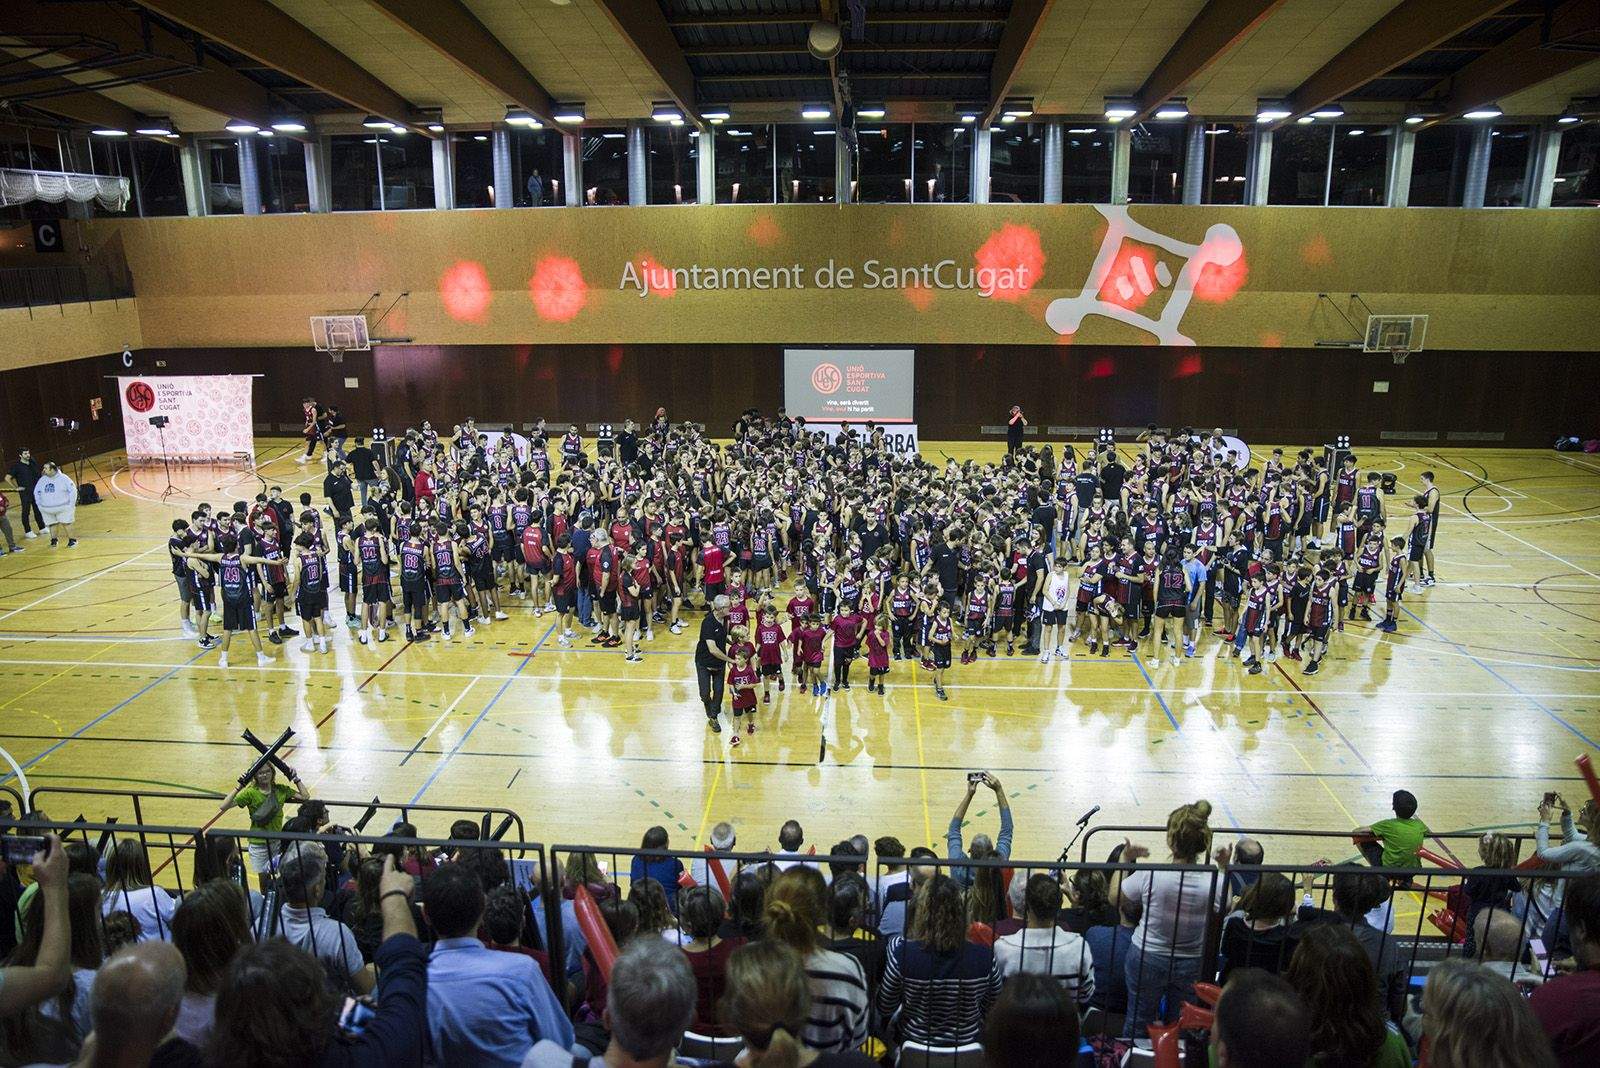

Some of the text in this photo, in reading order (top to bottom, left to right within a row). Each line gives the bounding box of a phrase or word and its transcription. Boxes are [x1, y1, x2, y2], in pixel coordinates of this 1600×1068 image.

[39, 225, 55, 246] C
[618, 260, 1029, 298] Ajuntament de SantCugat
[123, 350, 133, 367] C
[1163, 572, 1183, 589] 12
